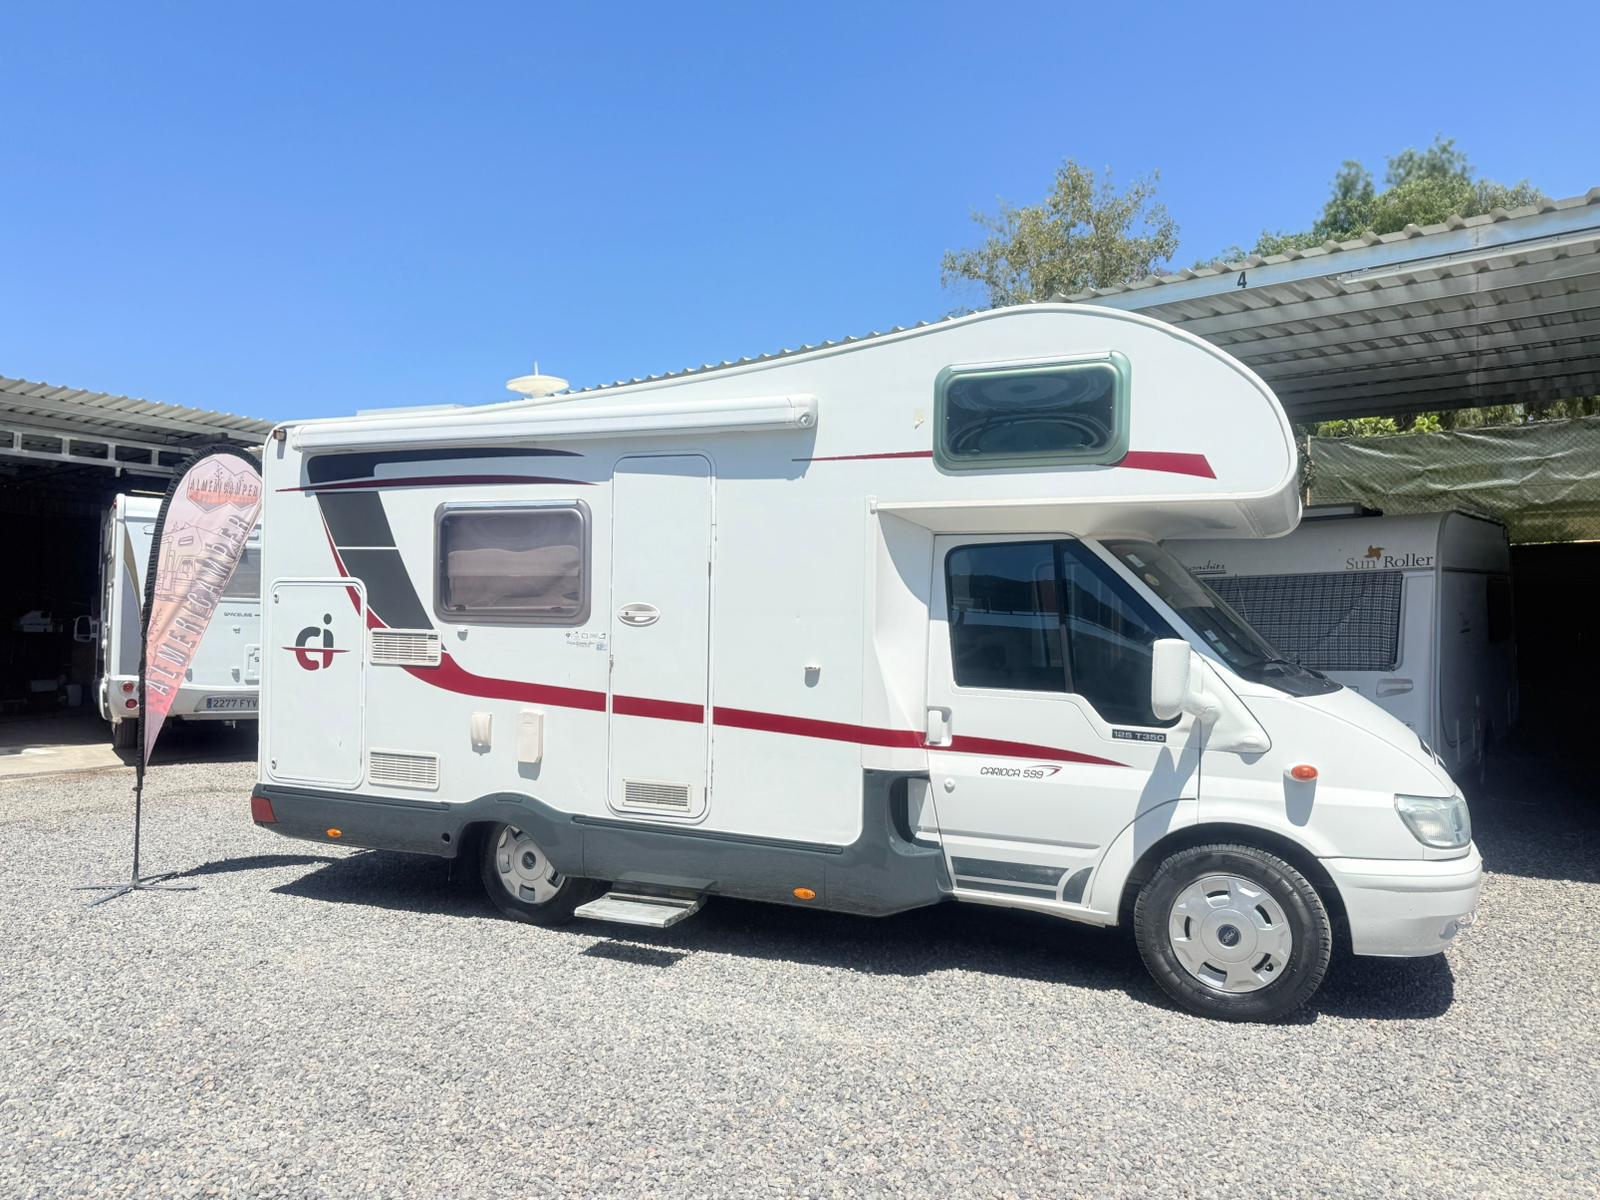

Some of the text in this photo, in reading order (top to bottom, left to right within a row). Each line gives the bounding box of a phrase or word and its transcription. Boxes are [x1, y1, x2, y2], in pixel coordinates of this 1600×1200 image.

[1237, 270, 1248, 289] 4
[189, 478, 259, 498] ALMERICAMPER
[1345, 553, 1434, 570] Sun Roller
[144, 514, 250, 697] ALMERICAMPER
[213, 699, 257, 708] 2277 FYV
[1113, 731, 1166, 743] 125 T350
[980, 766, 1044, 780] CARIOCA 599
